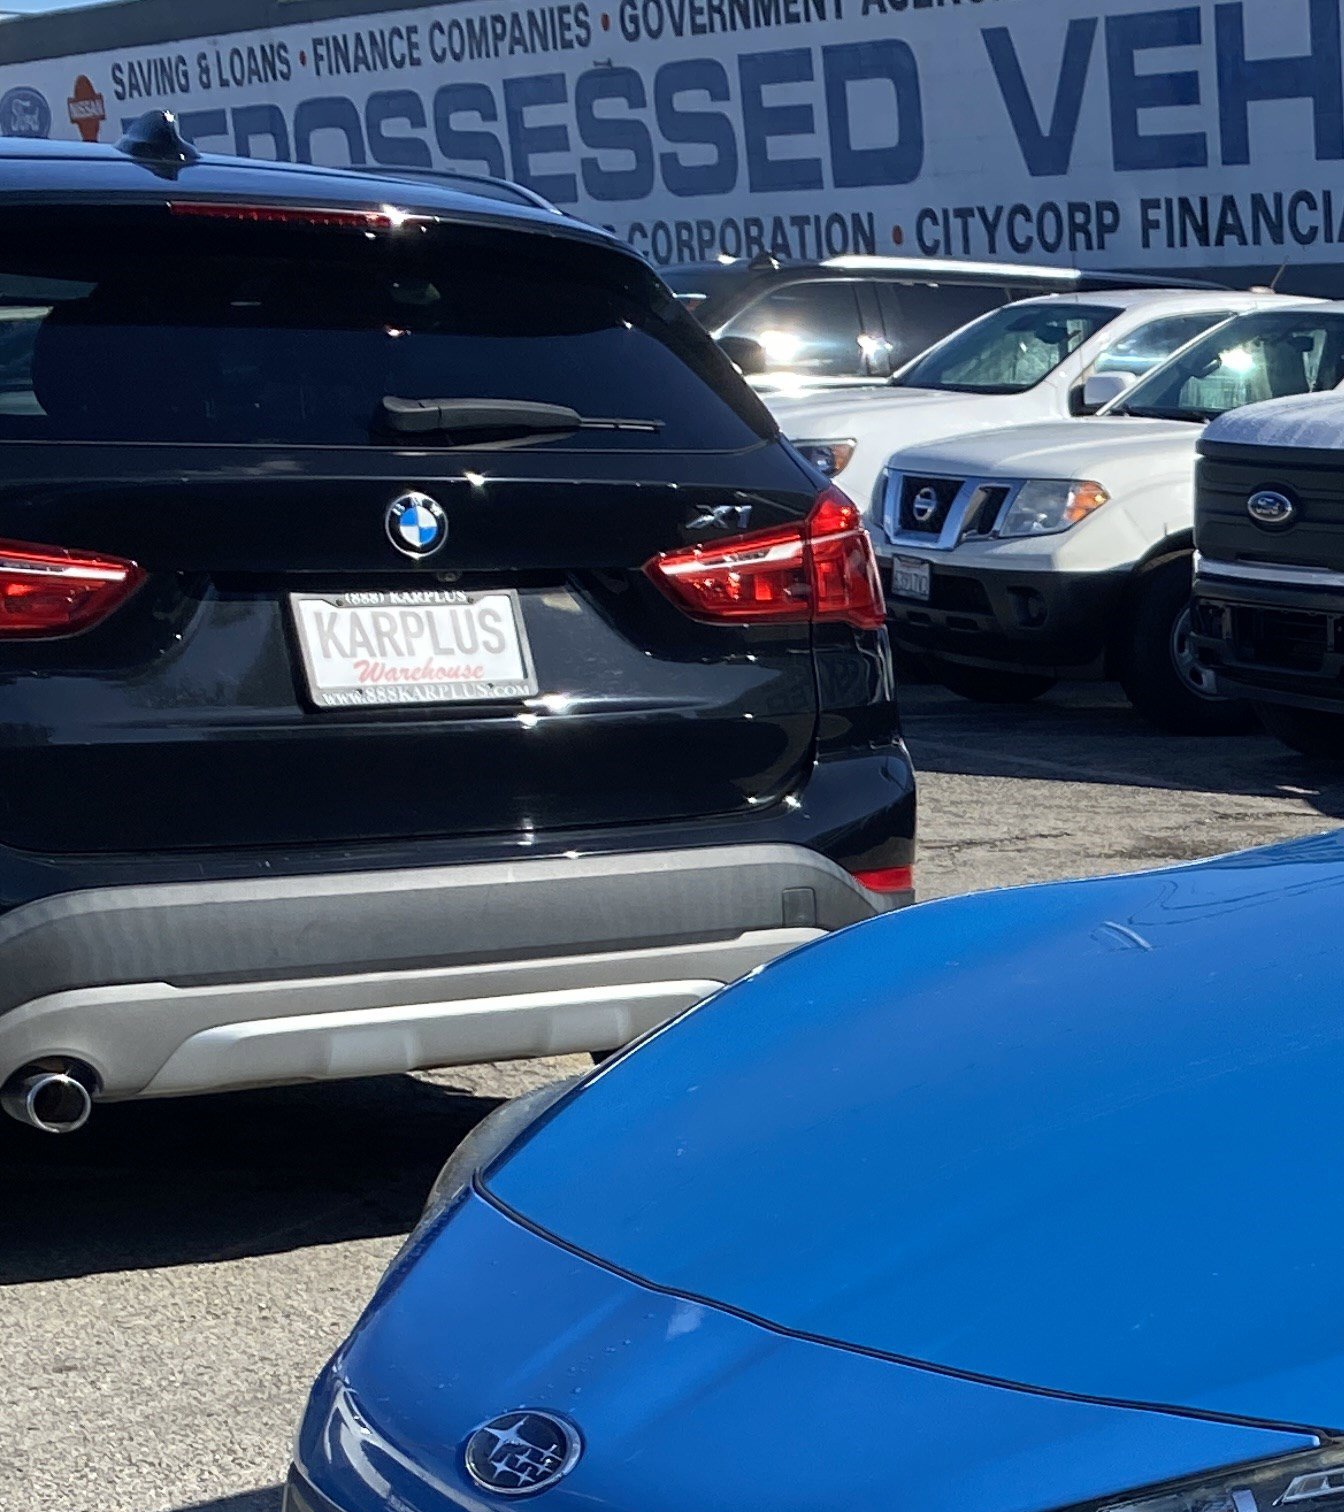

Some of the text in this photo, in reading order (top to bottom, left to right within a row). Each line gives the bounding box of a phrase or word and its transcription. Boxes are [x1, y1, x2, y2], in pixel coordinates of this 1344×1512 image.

[111, 55, 190, 101] SAVING
[196, 52, 212, 90] &
[215, 42, 292, 87] LOANS
[311, 25, 422, 77] FINANCE
[428, 3, 592, 64] COMPANIES
[915, 199, 1121, 256] CITYCORP
[313, 607, 506, 659] KARPLUS
[352, 657, 485, 684] Warehouse
